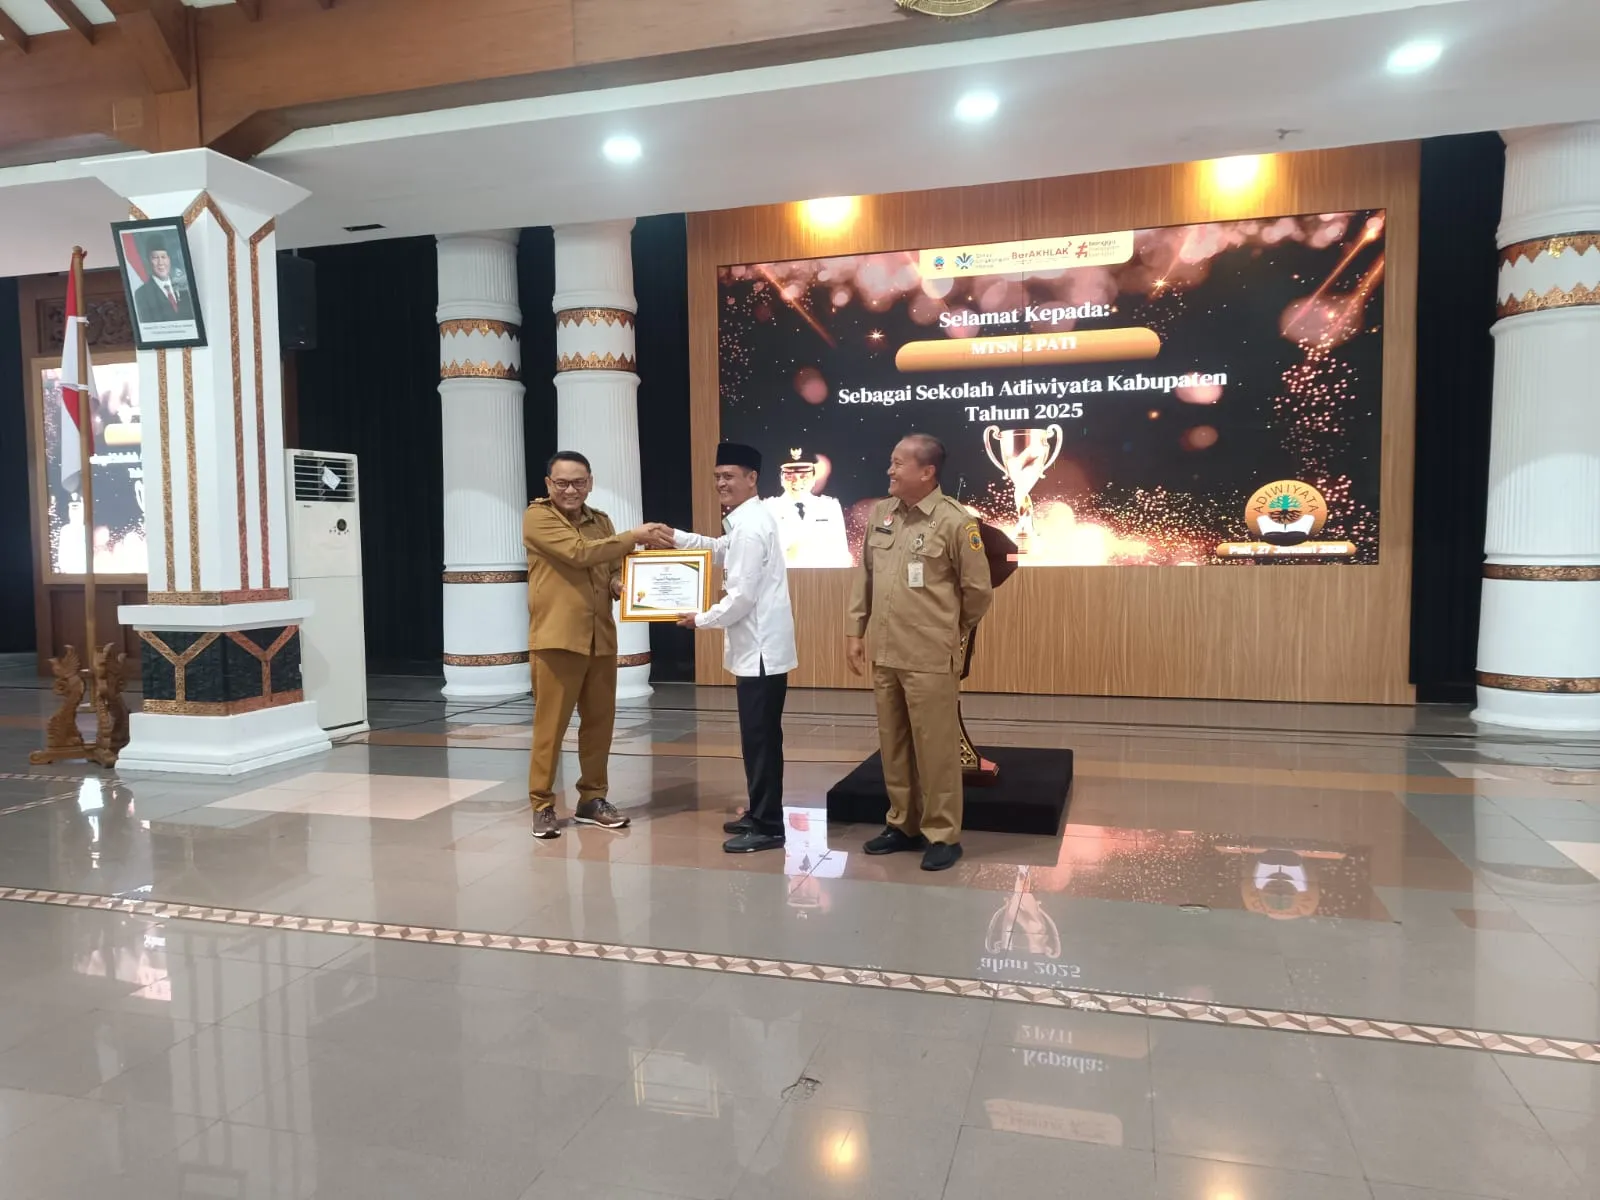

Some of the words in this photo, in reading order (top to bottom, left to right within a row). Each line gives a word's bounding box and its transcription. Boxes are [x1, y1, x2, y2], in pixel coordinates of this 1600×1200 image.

[1011, 246, 1069, 260] BerAKHLAK
[939, 310, 1019, 327] Selamat
[1024, 302, 1110, 324] Kepada:
[1022, 339, 1033, 352] 2
[1035, 336, 1077, 352] PATI
[838, 384, 912, 406] Sebagai
[915, 381, 994, 401] Sekolah
[999, 376, 1103, 400] Adiwiyata
[1107, 372, 1228, 394] Kabupaten
[964, 404, 1030, 421] Tahun
[1034, 402, 1084, 419] 2025
[1253, 483, 1319, 513] ADIWIYATA
